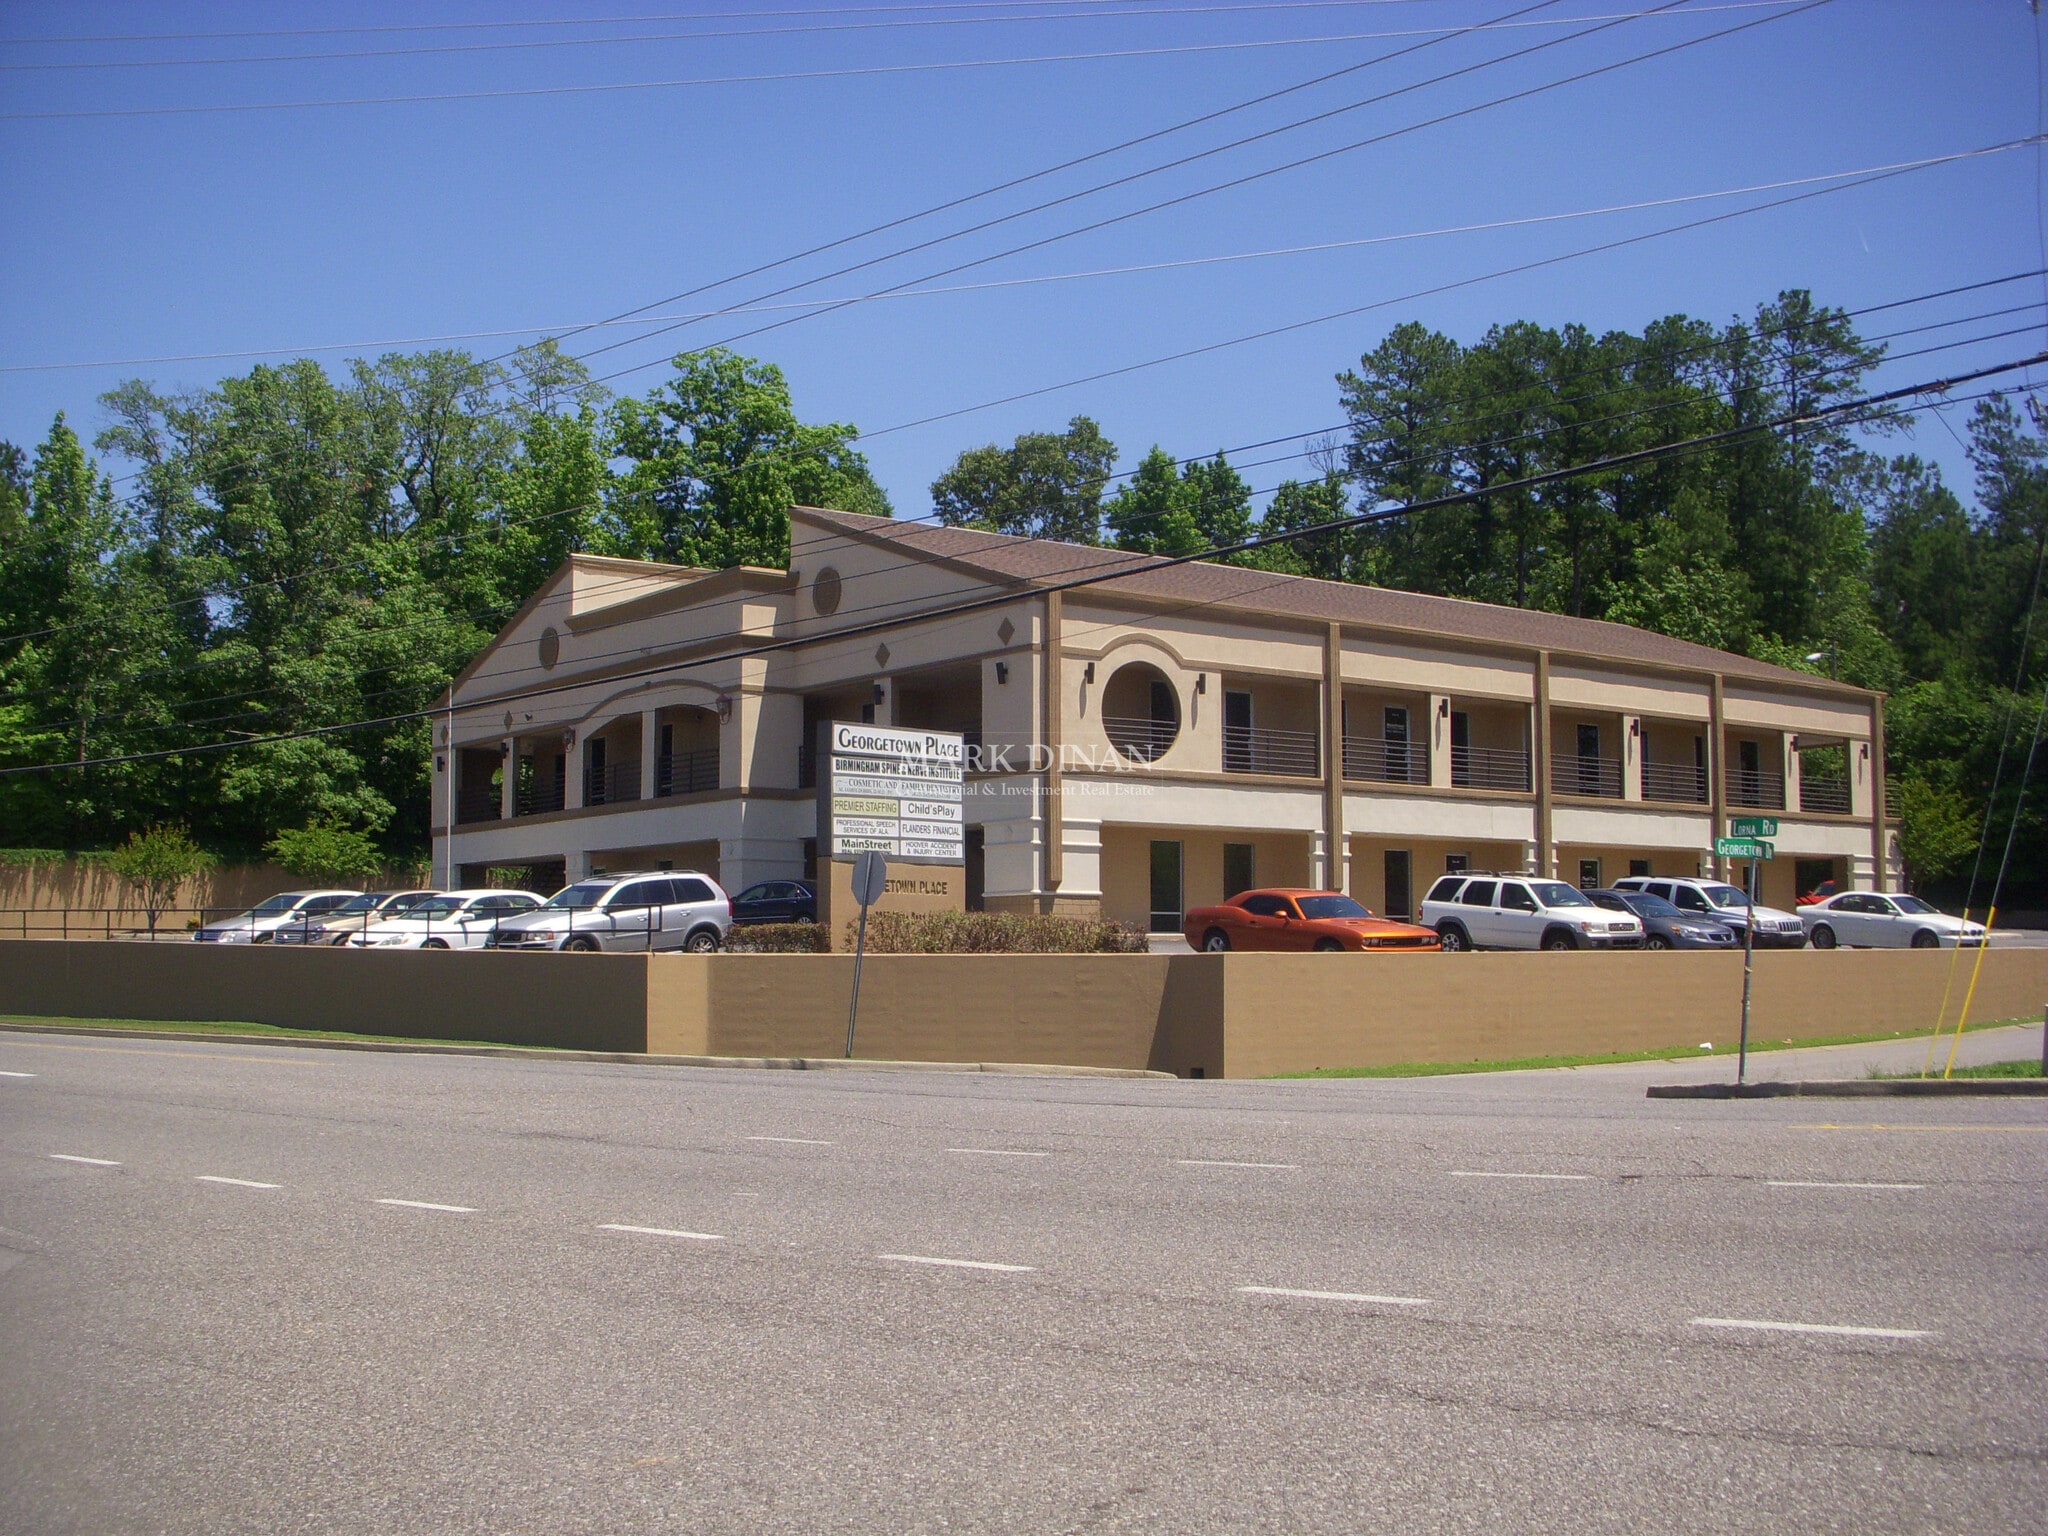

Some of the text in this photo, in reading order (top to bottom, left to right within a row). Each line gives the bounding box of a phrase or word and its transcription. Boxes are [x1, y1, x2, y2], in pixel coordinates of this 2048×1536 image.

[838, 727, 960, 758] GEORGETOWN PLACE
[835, 759, 881, 774] BIRMINGHAM
[881, 762, 900, 775] SPINE
[907, 765, 927, 777] NERVE
[928, 766, 960, 780] INSTITUTE
[848, 779, 882, 789] COSMETIC
[884, 781, 898, 790] AND
[834, 799, 897, 813] PREMIER STAFFING
[836, 819, 874, 828] PROFESSIONAL
[843, 826, 868, 834] SERVICES
[902, 823, 960, 836] FLANDERS FINANCIAL
[1733, 819, 1775, 836] LORNA RD
[841, 839, 892, 850] MainStreet
[1718, 838, 1763, 857] GEORGETOWN
[884, 879, 948, 895] ETOWN PLACE
